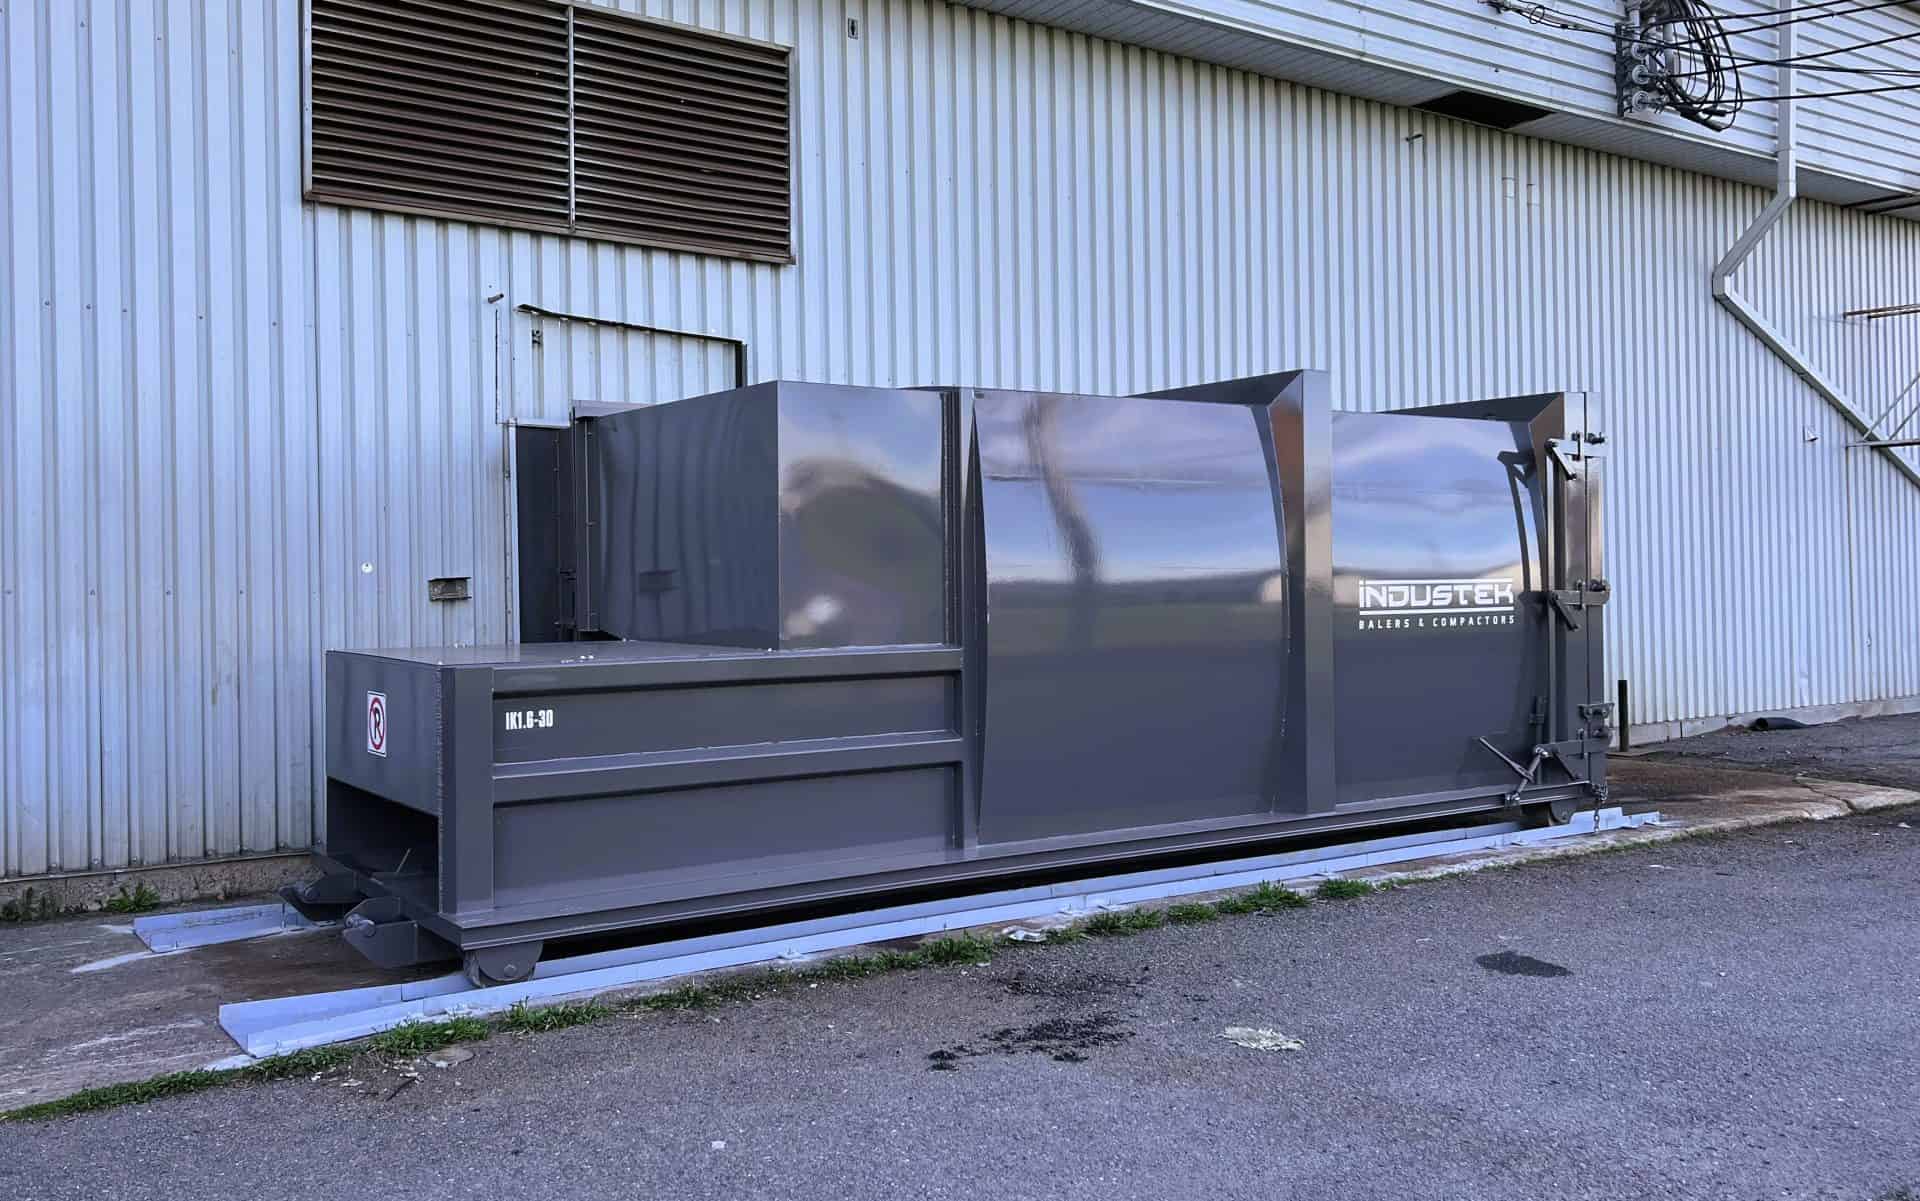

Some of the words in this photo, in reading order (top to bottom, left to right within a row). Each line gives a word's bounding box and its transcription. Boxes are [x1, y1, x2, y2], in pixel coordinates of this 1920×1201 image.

[1359, 618, 1410, 630] BALERS
[1419, 617, 1425, 627] &
[1432, 615, 1514, 628] COMPACTORS
[505, 709, 553, 730] IK1.6-30
